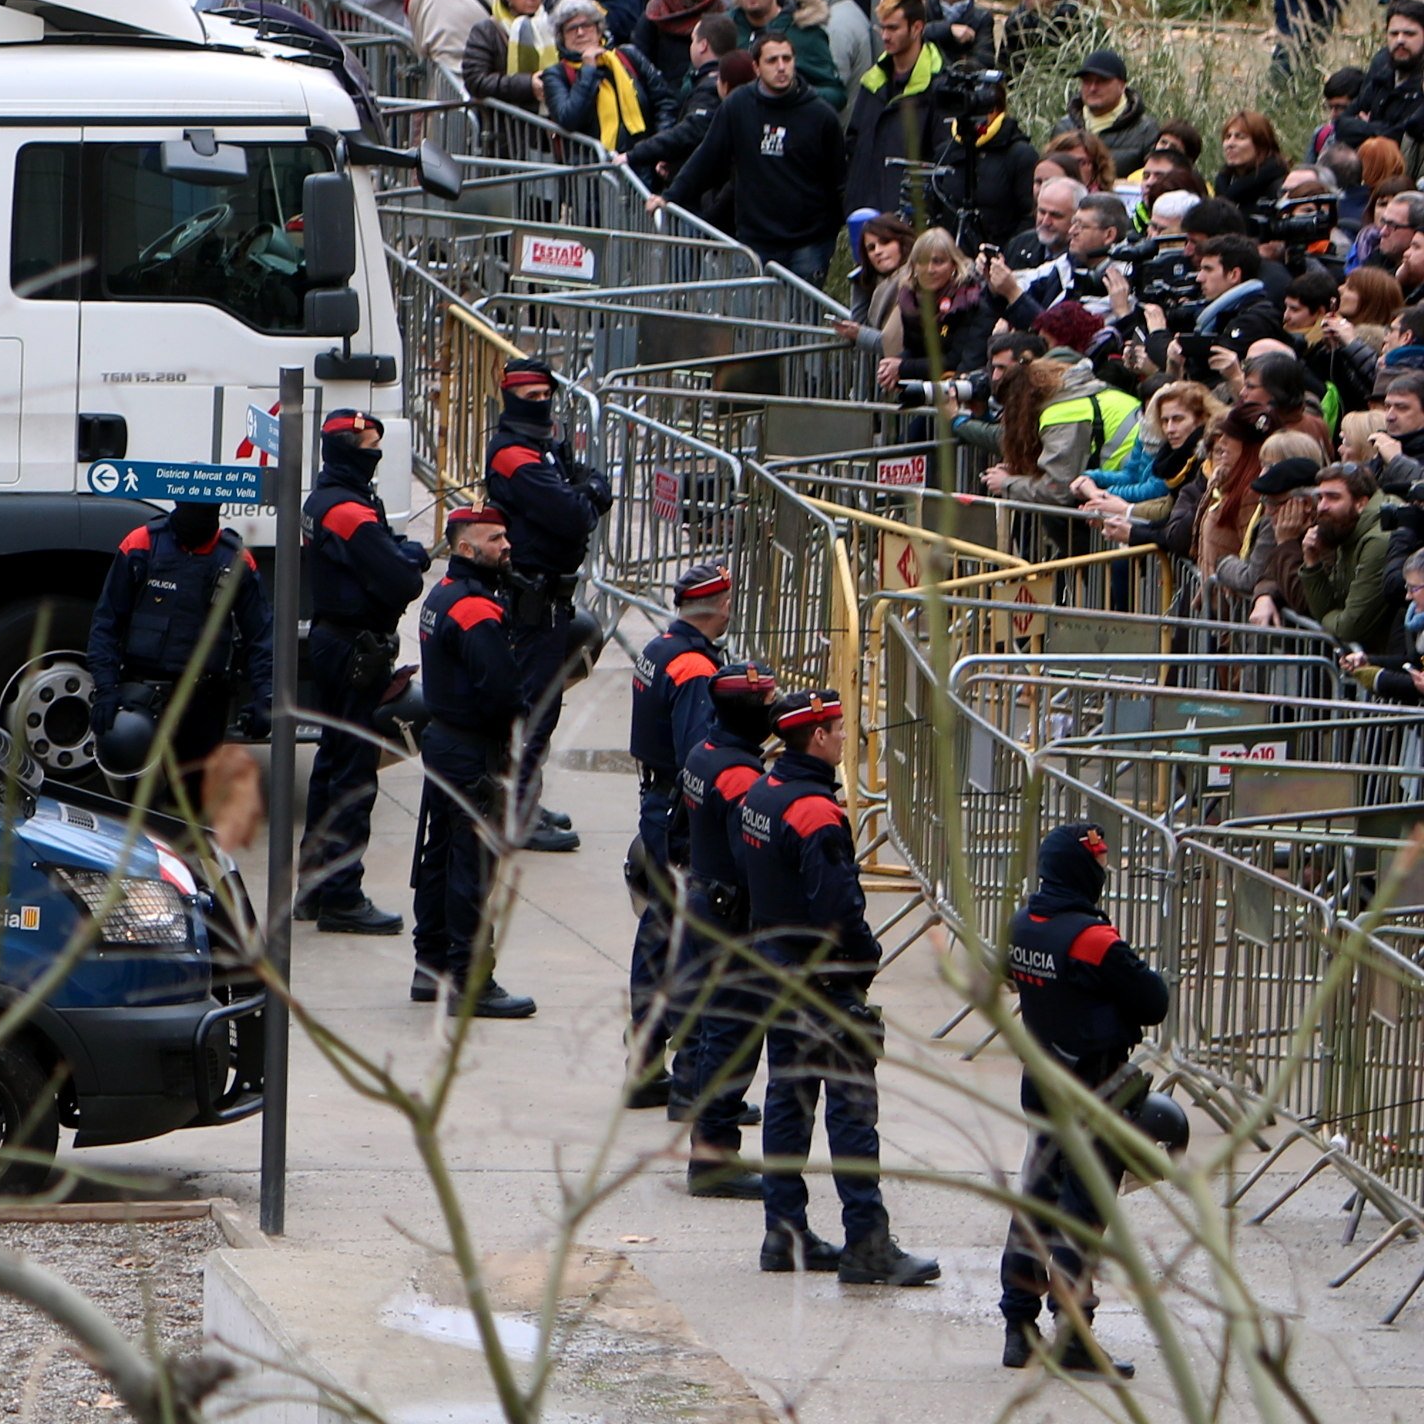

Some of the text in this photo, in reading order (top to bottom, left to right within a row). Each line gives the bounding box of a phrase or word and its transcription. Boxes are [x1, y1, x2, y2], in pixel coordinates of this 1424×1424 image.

[101, 371, 187, 383] TGM 15.280
[156, 468, 256, 483] Districte Mercat del Pla
[166, 484, 256, 498] Turó de la Seu Vella
[219, 503, 278, 519] Quero
[741, 805, 771, 834] POLICIA
